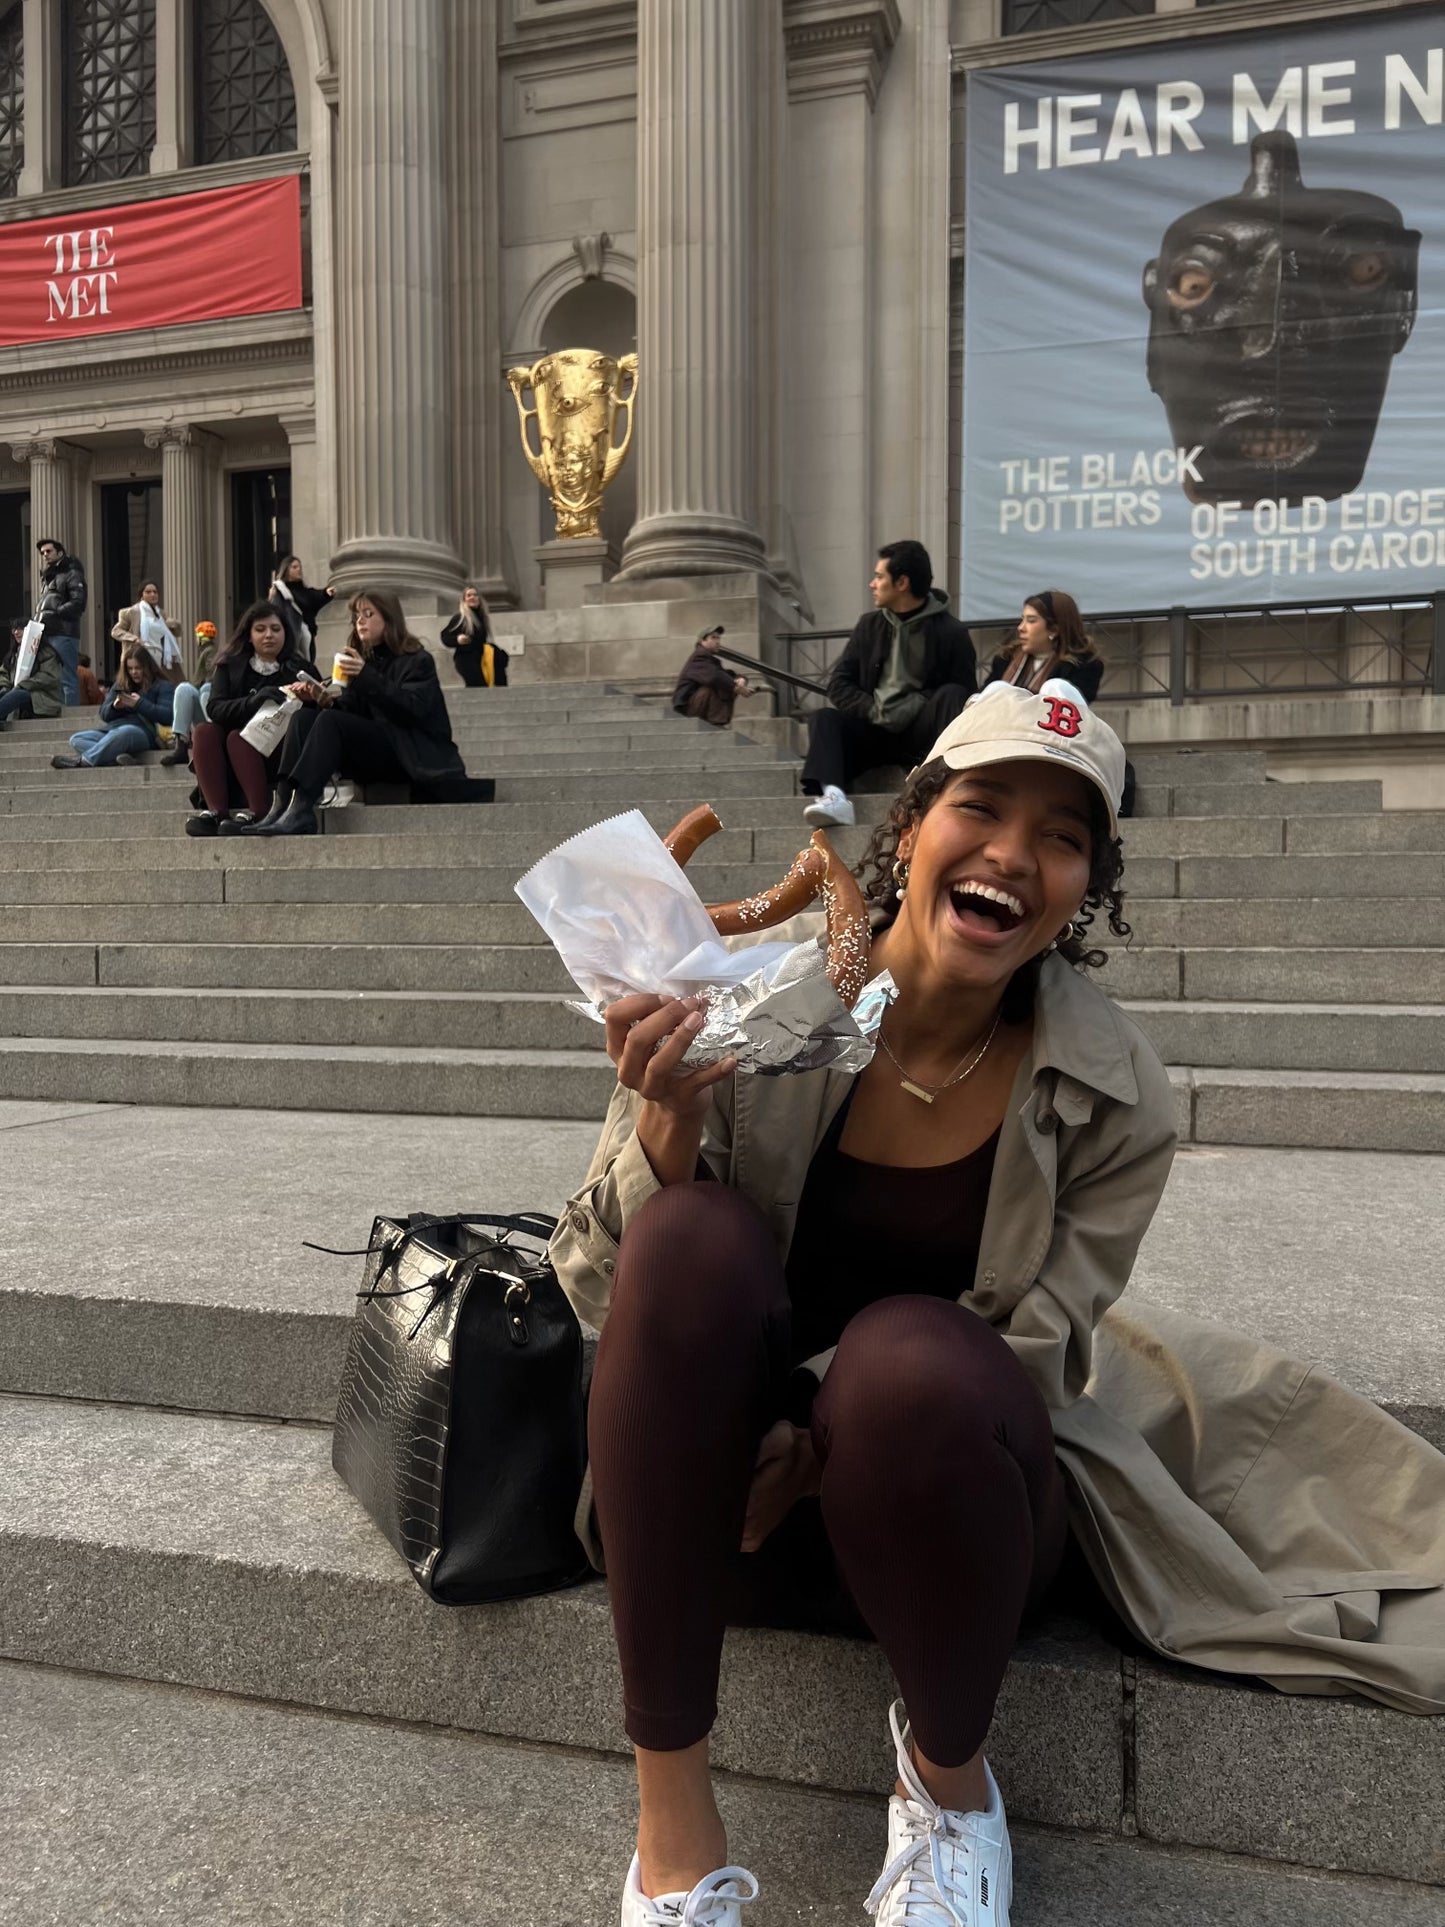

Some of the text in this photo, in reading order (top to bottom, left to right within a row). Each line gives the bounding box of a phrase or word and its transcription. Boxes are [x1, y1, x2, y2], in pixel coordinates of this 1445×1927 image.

[1003, 48, 1443, 174] HEAR ME N
[44, 226, 116, 274] THE
[45, 271, 118, 322] MET
[1000, 445, 1205, 495] THE BLACK
[1000, 489, 1162, 535] POTTERS
[1191, 487, 1445, 540] OF OLD EDGE
[1189, 537, 1316, 580] SOUTH
[1037, 696, 1083, 738] B
[980, 1874, 989, 1908] PUMA
